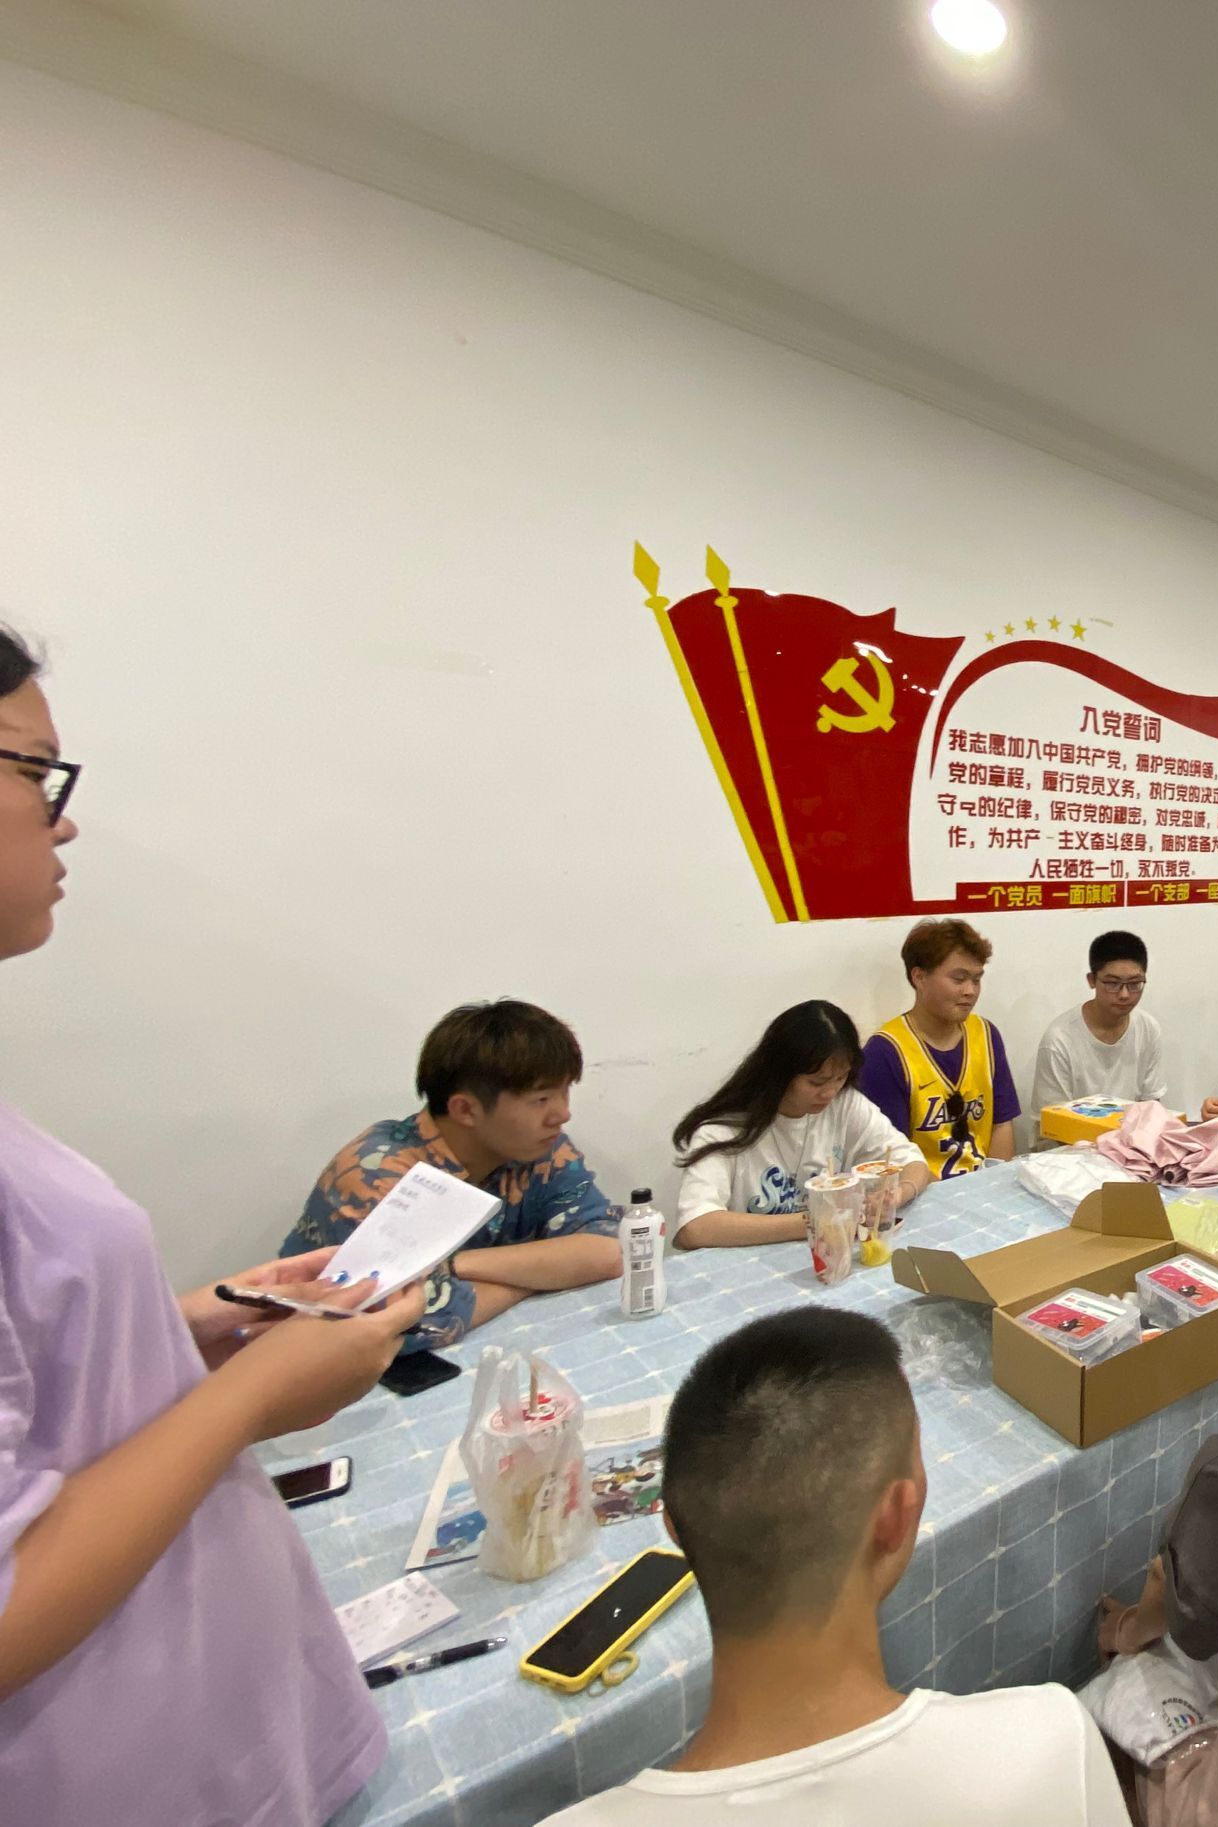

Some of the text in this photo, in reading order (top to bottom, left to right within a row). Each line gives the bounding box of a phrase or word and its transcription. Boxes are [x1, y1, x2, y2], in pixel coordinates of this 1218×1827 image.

[1080, 705, 1162, 744] 入党誓词
[967, 885, 1043, 908] 一个党员
[1135, 882, 1191, 903] 一个支部
